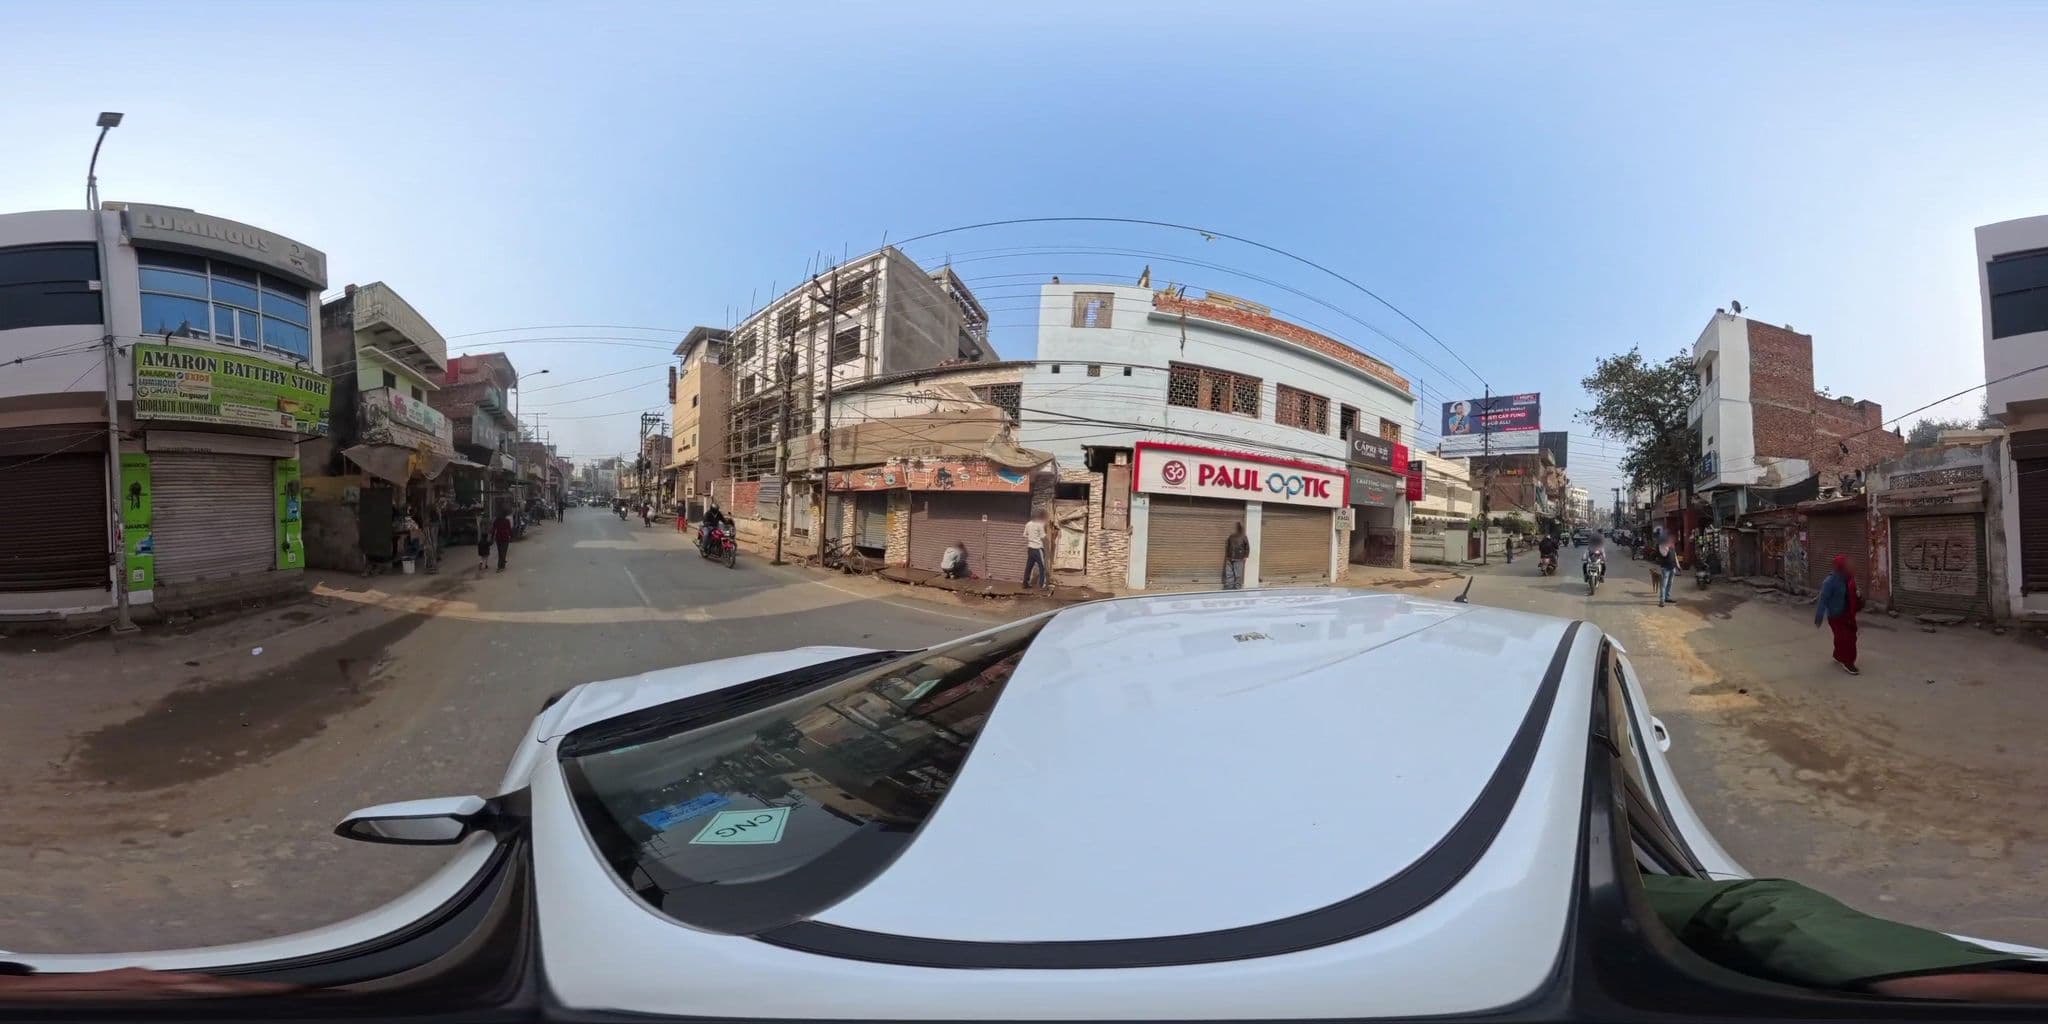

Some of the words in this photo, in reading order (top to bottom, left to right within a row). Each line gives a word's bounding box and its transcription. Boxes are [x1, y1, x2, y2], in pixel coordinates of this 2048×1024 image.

[139, 213, 271, 253] LUMINOUS
[142, 351, 217, 372] AMARON
[223, 361, 287, 386] BATTERY
[291, 375, 328, 396] STORE
[1198, 463, 1263, 493] PAUL
[715, 814, 773, 838] CNG
